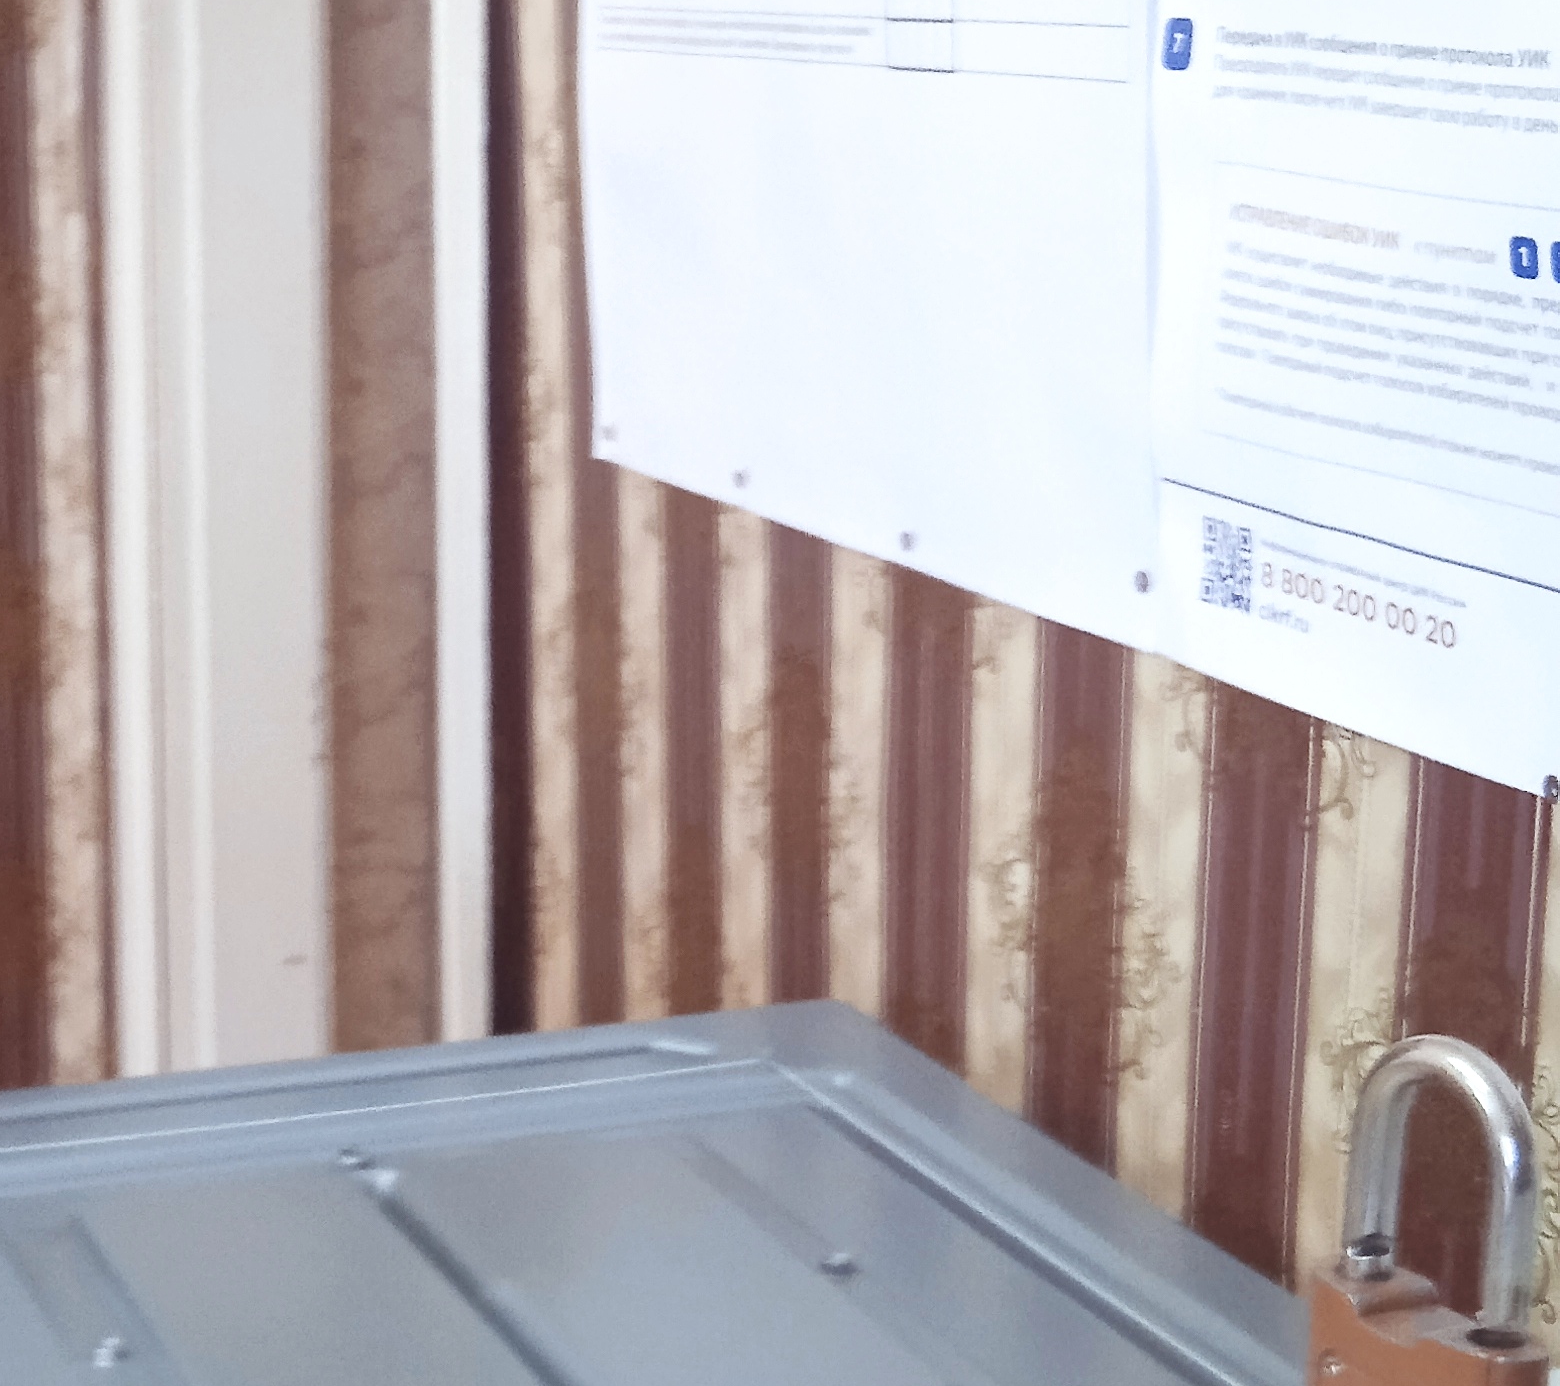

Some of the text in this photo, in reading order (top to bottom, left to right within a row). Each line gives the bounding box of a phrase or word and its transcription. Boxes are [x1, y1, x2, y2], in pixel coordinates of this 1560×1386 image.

[1261, 562, 1273, 588] 8
[1281, 567, 1324, 604] 800
[1332, 583, 1376, 623] 200
[1385, 601, 1417, 635] 00
[1425, 614, 1457, 649] 20
